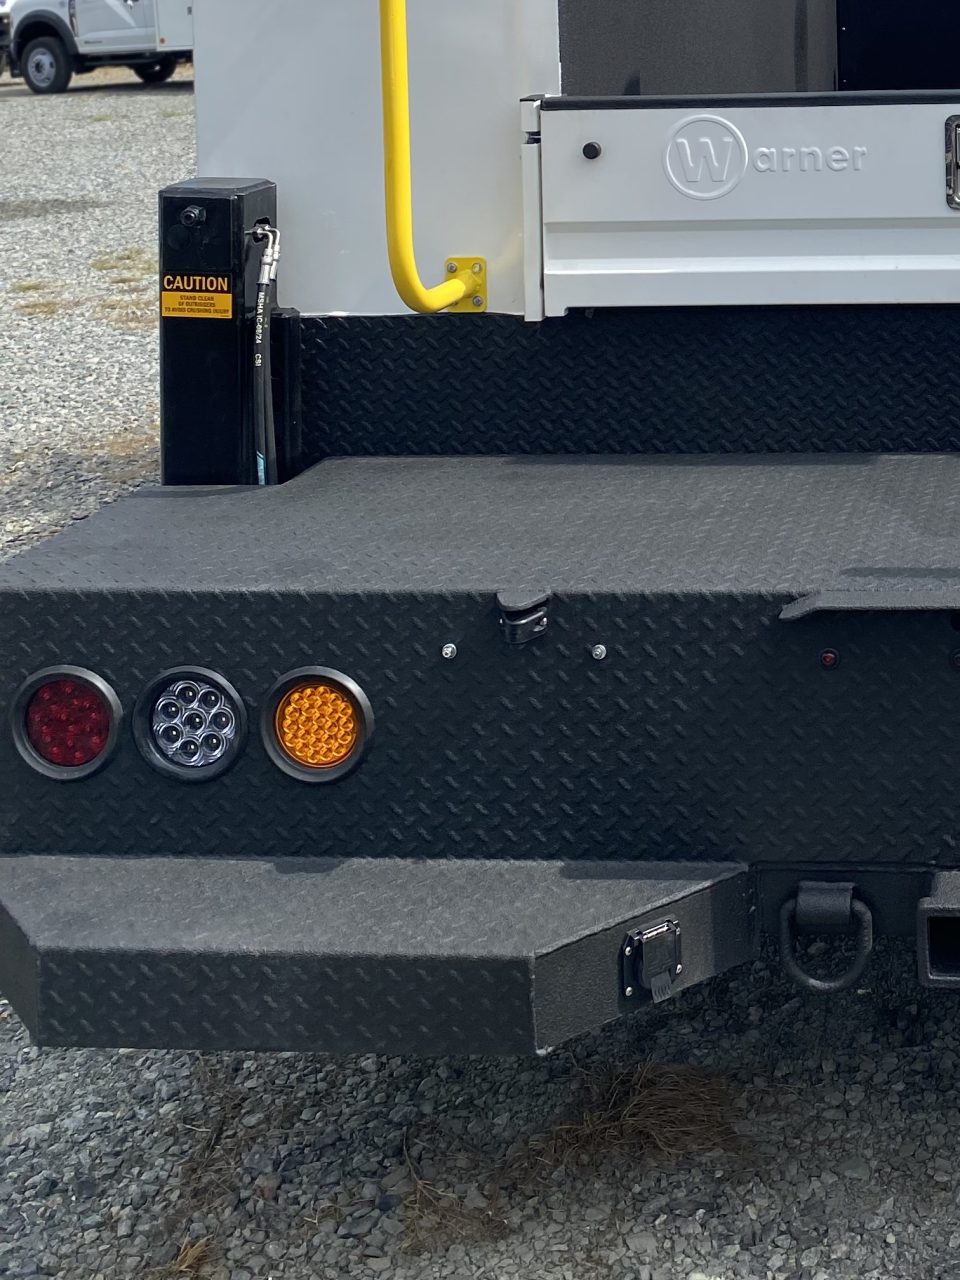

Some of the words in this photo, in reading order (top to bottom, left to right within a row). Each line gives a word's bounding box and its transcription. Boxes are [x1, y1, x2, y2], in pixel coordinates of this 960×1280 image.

[672, 132, 868, 186] Warner
[163, 275, 228, 291] CAUTION
[257, 291, 265, 314] MSHA
